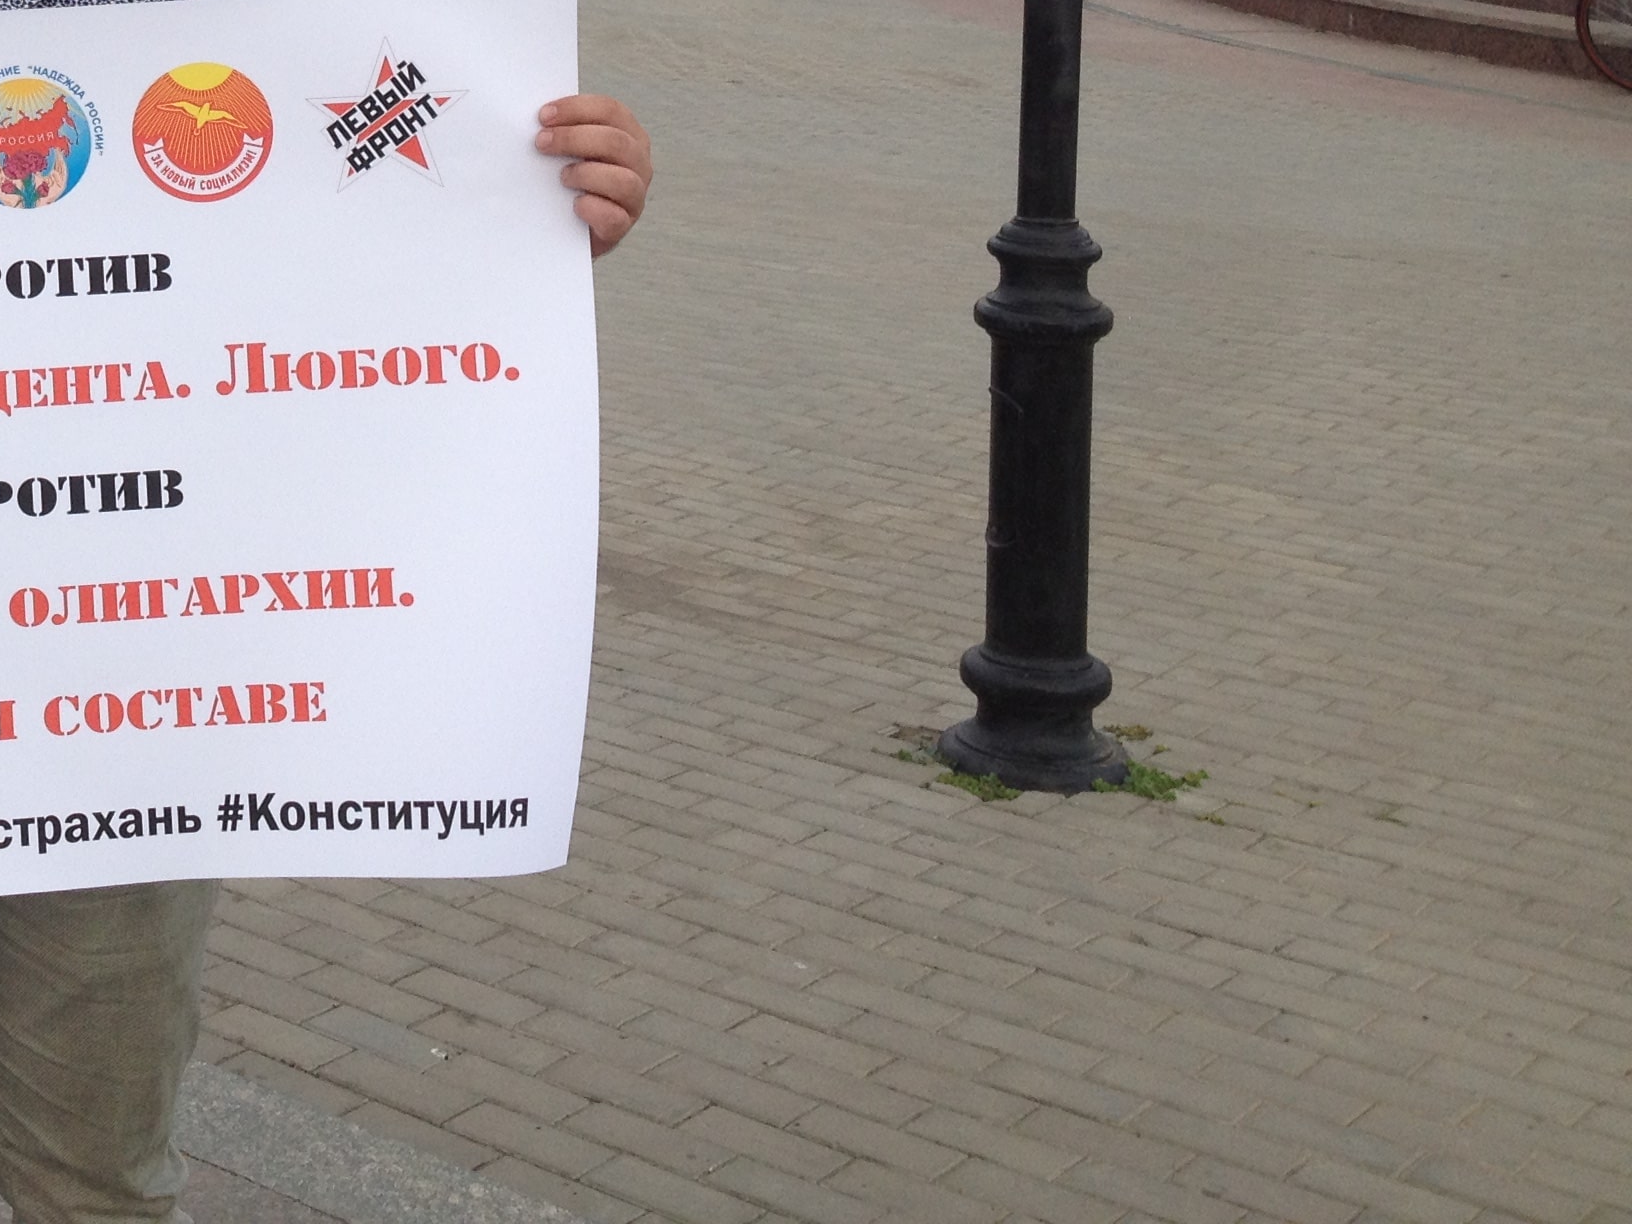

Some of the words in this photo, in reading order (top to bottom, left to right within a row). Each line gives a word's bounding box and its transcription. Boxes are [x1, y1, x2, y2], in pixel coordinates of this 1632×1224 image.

[326, 60, 427, 150] ЛЕВЫЙ
[346, 93, 438, 173] ФРОНТ
[151, 153, 164, 169] ЗА
[161, 165, 197, 191] НОВЫЙ
[199, 149, 257, 191] СОЦИАЛИЗМ!
[216, 792, 529, 841] #Конституция
